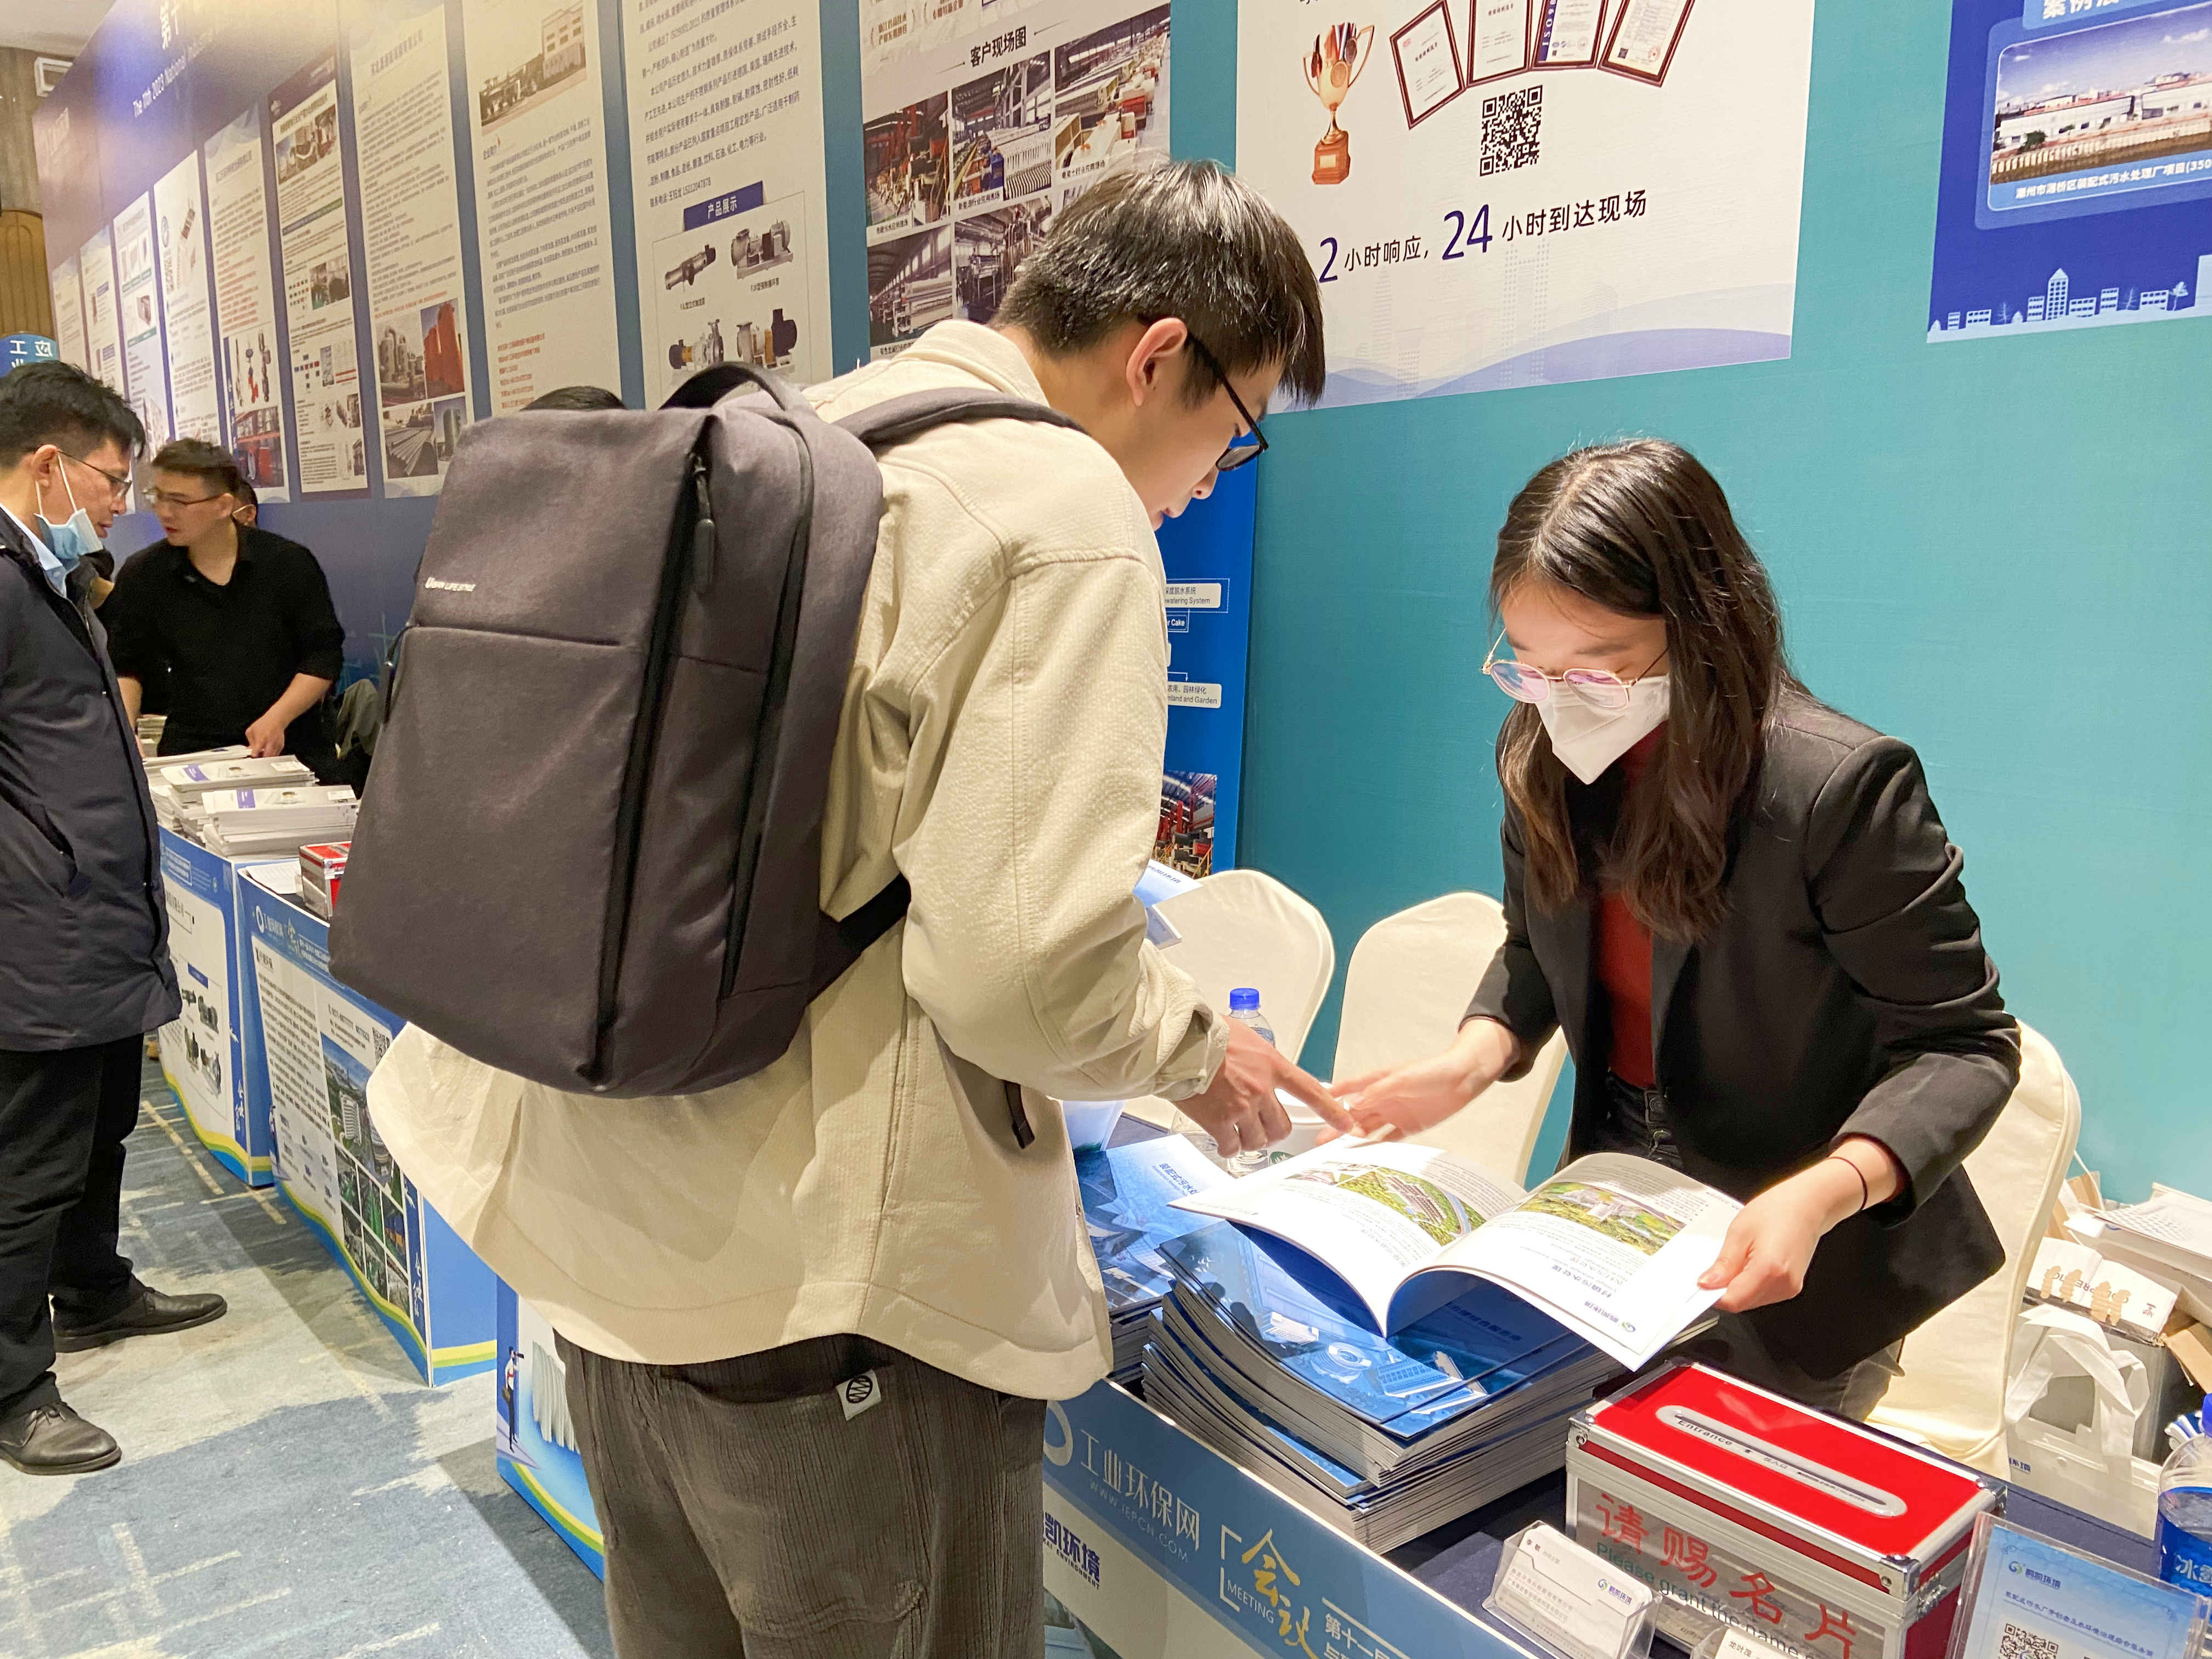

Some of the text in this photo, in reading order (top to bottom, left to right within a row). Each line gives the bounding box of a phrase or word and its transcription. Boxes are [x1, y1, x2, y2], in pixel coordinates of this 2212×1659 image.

[970, 25, 1027, 68] 客户现场图
[708, 195, 737, 219] 产品展示
[1189, 597, 1211, 605] System
[1171, 618, 1186, 627] Cake
[1194, 696, 1217, 704] Garden
[1677, 1419, 1733, 1446] Entrance
[1080, 1429, 1200, 1552] 工业环保网
[1043, 1511, 1100, 1583] 凯环境
[1227, 1579, 1274, 1624] MEETING
[1596, 1541, 1656, 1585] Please
[1659, 1576, 1706, 1613] grant
[1710, 1603, 1741, 1627] the
